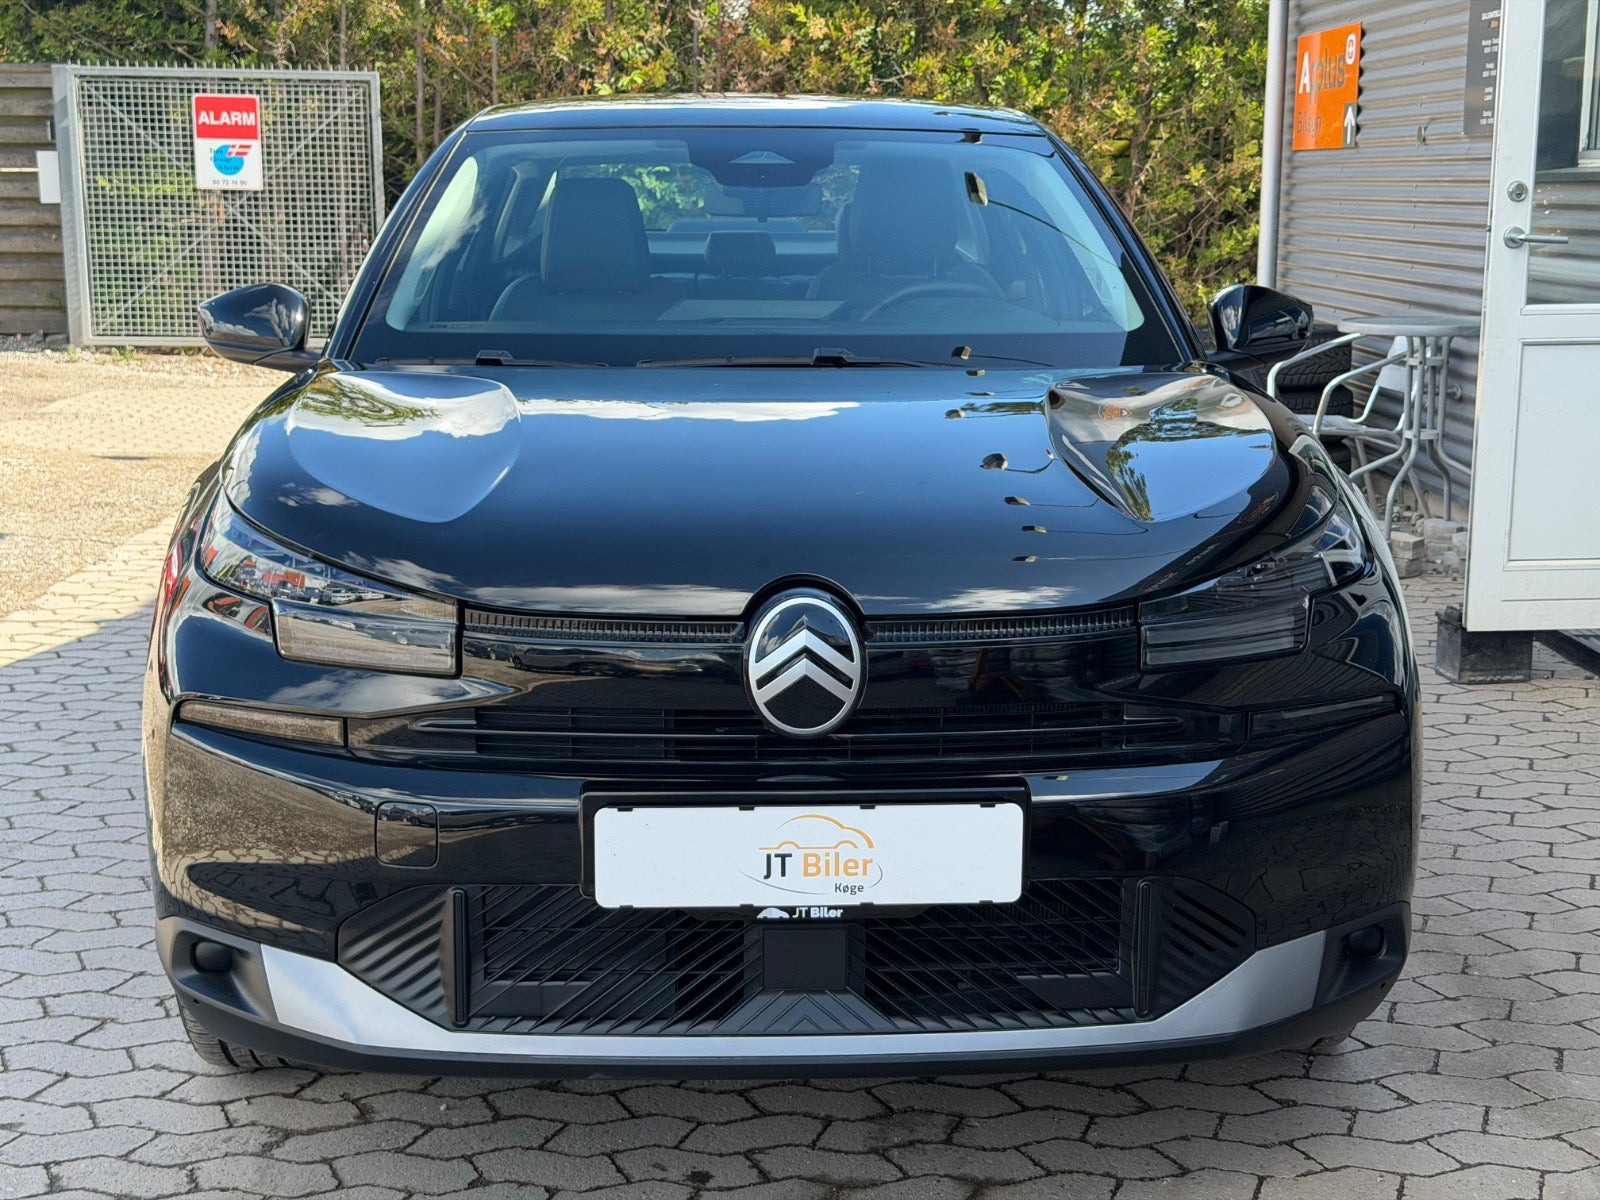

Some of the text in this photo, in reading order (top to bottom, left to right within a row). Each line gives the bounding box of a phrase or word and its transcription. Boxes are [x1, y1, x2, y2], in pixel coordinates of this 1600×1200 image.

[198, 110, 256, 126] ALARM
[763, 851, 874, 880] JT Biler
[834, 883, 864, 895] Køge
[792, 906, 844, 918] JT Biler
